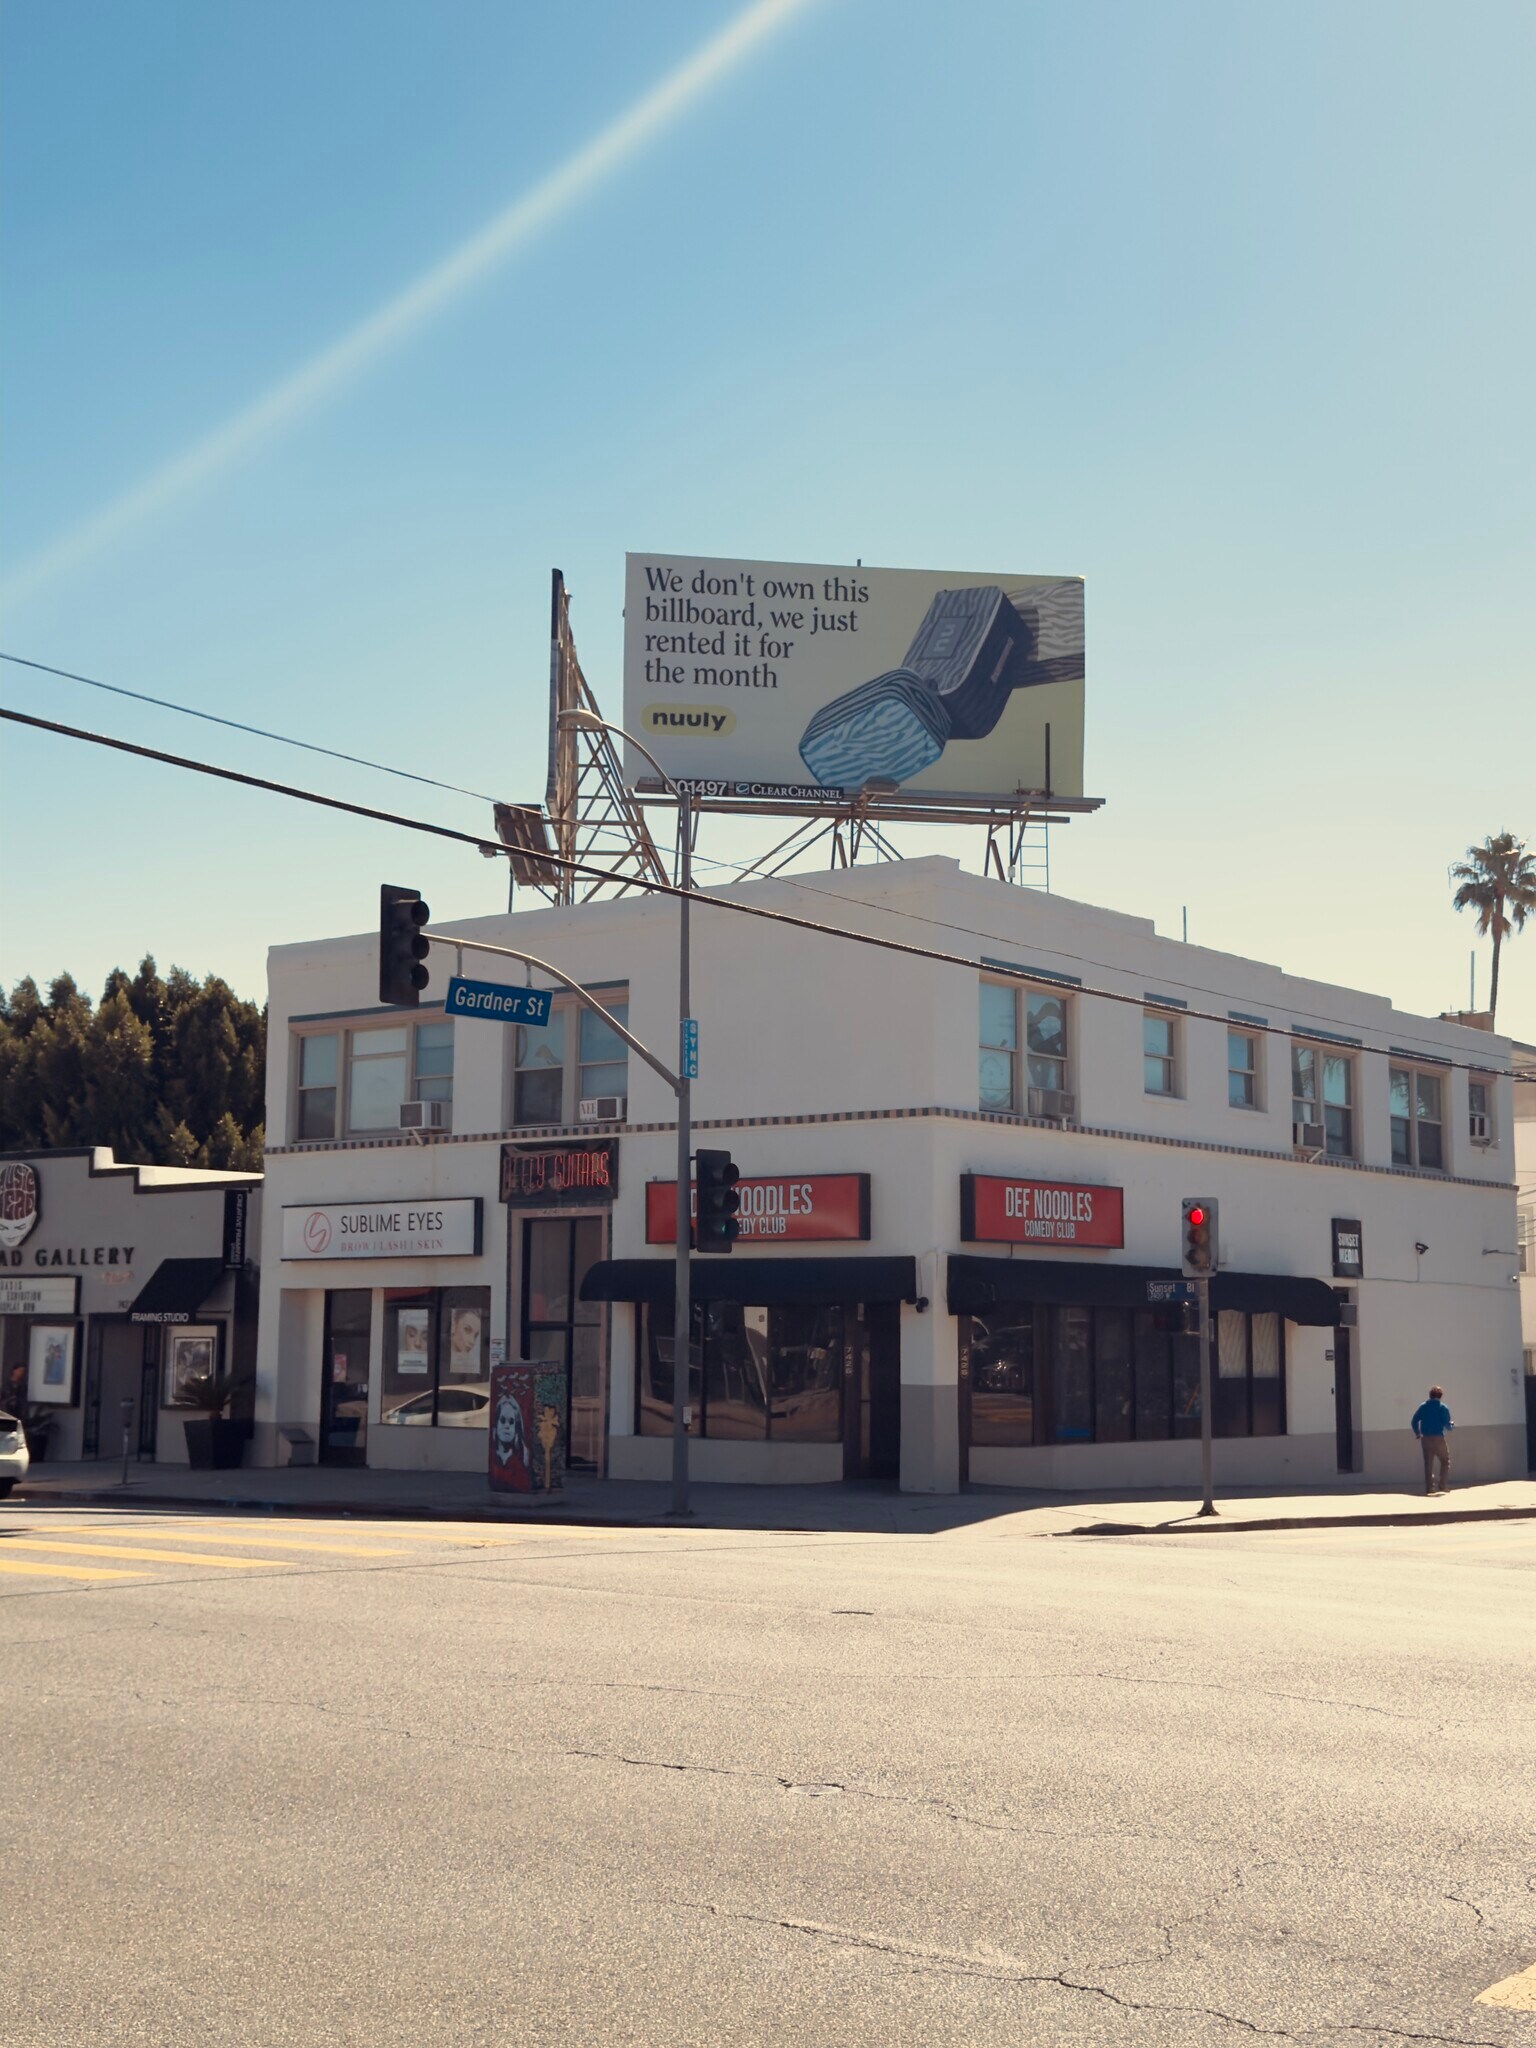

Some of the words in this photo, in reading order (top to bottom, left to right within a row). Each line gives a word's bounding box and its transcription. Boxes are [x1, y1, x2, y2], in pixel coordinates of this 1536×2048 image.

[645, 567, 684, 593] We
[691, 570, 756, 597] don't
[763, 579, 815, 600] own
[823, 577, 870, 603] this
[645, 597, 763, 631] billboard,
[770, 609, 803, 630] we
[810, 605, 858, 634] just
[645, 630, 725, 656] rented
[734, 630, 751, 657] it
[759, 631, 794, 660] for
[645, 658, 685, 684] the
[693, 663, 778, 689] month
[652, 711, 727, 731] nuuly
[455, 986, 521, 1013] Gardner
[526, 997, 545, 1017] St
[689, 1022, 697, 1075] SYNC
[553, 1151, 610, 1188] GUITARS
[1005, 1186, 1030, 1218] DEF
[1034, 1188, 1093, 1223] NOODLES
[340, 1213, 401, 1234] SUBLIME
[408, 1211, 443, 1231] EYES
[759, 1216, 786, 1234] CLUB
[1024, 1219, 1055, 1239] COMEDY
[1056, 1221, 1075, 1239] CLUB
[340, 1240, 368, 1252] BROW
[379, 1239, 407, 1251] LASH
[417, 1238, 443, 1250] SKIN
[1337, 1232, 1359, 1247] SUNSET
[35, 1247, 135, 1267] GALLERY
[1338, 1248, 1360, 1264] MEDIA
[1149, 1282, 1176, 1294] Sunset
[131, 1312, 163, 1322] FRAMING
[163, 1312, 189, 1323] STUDIO
